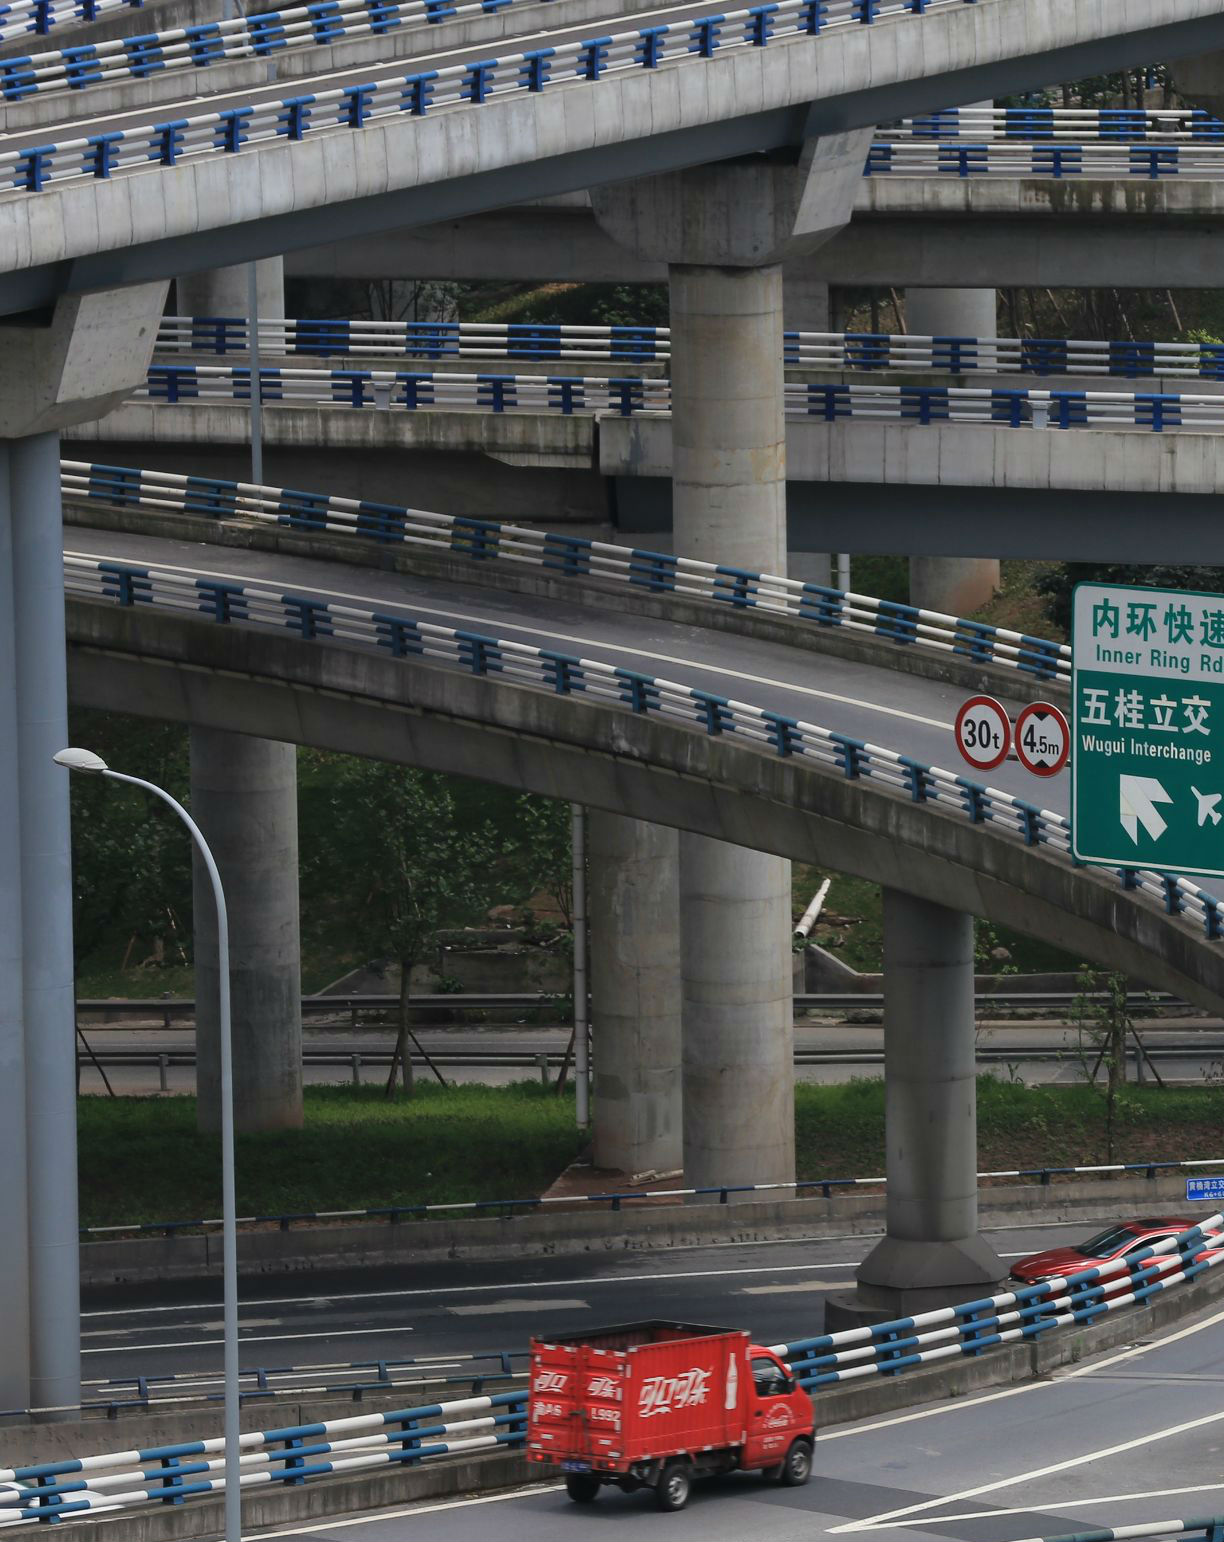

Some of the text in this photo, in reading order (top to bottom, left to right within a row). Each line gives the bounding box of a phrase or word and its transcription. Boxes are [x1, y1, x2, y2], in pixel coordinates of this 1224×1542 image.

[1096, 644, 1142, 665] Inner
[1150, 648, 1190, 674] Ring
[1080, 688, 1212, 736] 五桂立交
[963, 718, 1000, 749] 30t
[1022, 724, 1059, 755] 4.5m
[1081, 734, 1211, 765] Wugui Interchange
